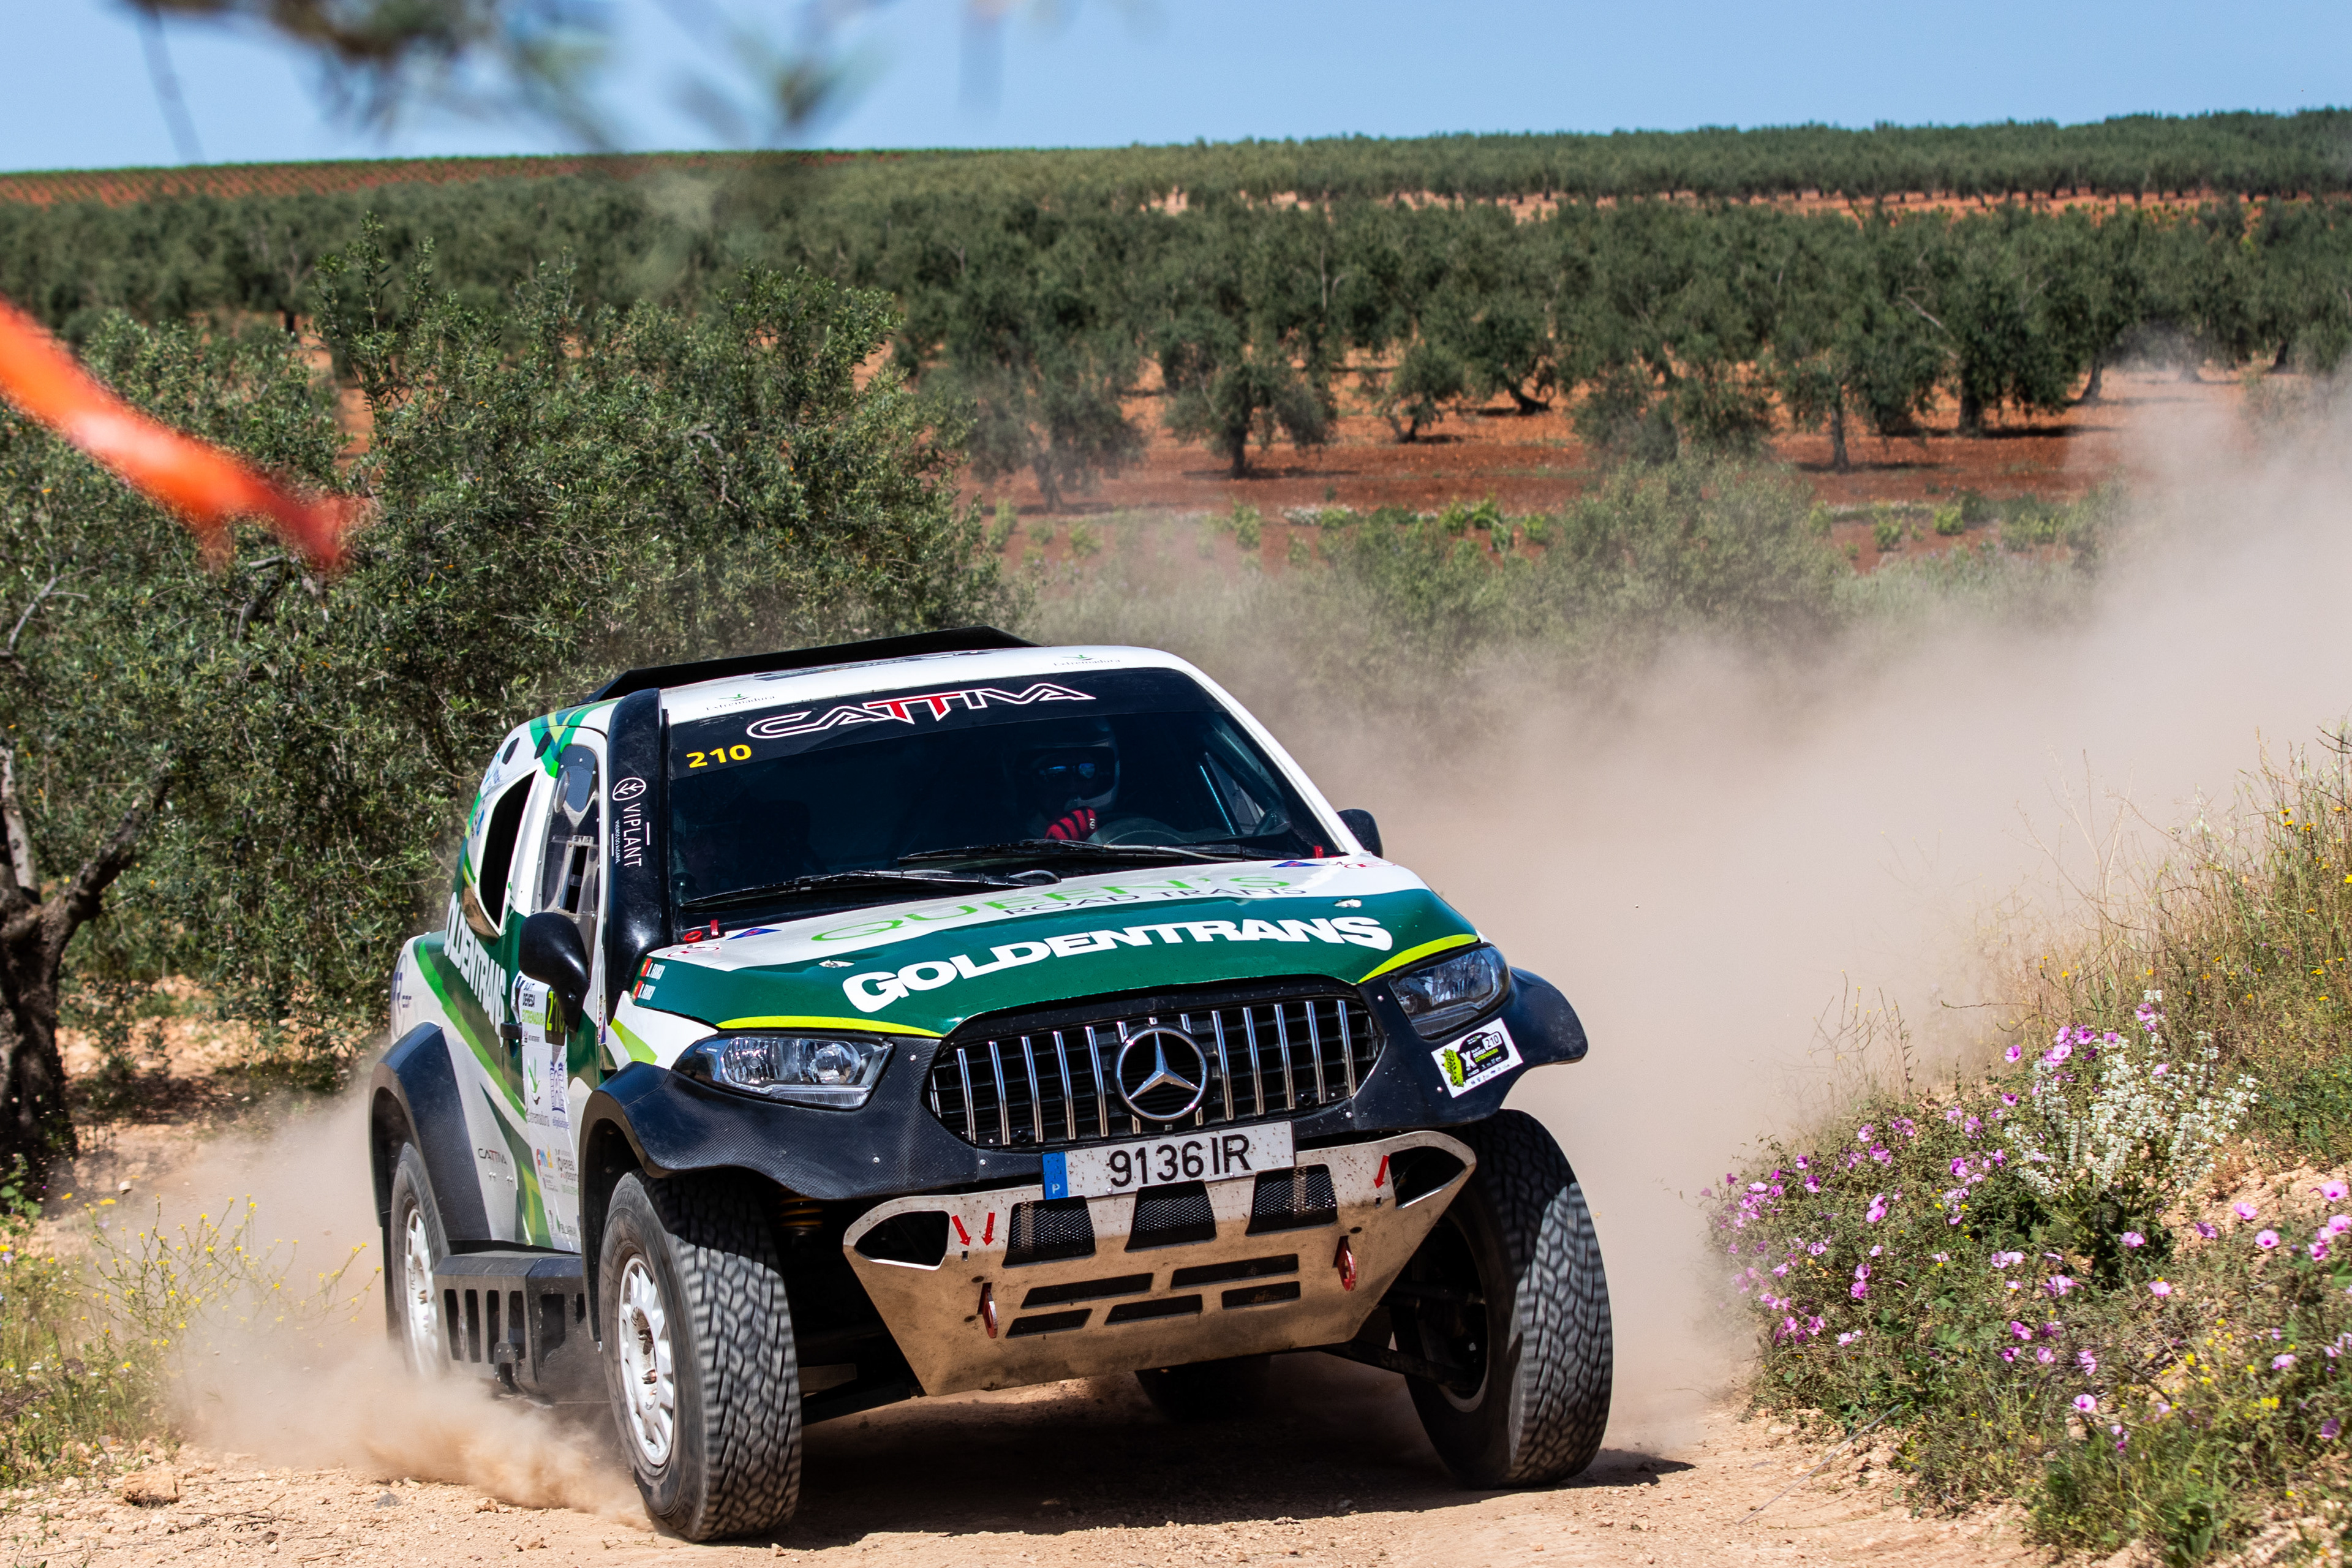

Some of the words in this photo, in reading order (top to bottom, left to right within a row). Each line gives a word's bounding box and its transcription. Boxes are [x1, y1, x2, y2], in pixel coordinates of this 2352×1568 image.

[746, 683, 1096, 739] CATTIVA
[686, 744, 752, 768] 210
[623, 802, 642, 867] VIPLANT
[810, 876, 1291, 941] QUEEN'S
[1003, 894, 1140, 915] ROAD
[1152, 887, 1307, 899] TRANS
[443, 891, 507, 1048] OLDENTRANS
[842, 916, 1393, 1013] GOLDENTRANS
[1485, 1035, 1500, 1048] 210
[478, 1148, 508, 1166] CATTIVA
[1110, 1134, 1252, 1188] 9136IR
[1052, 1183, 1060, 1194] P
